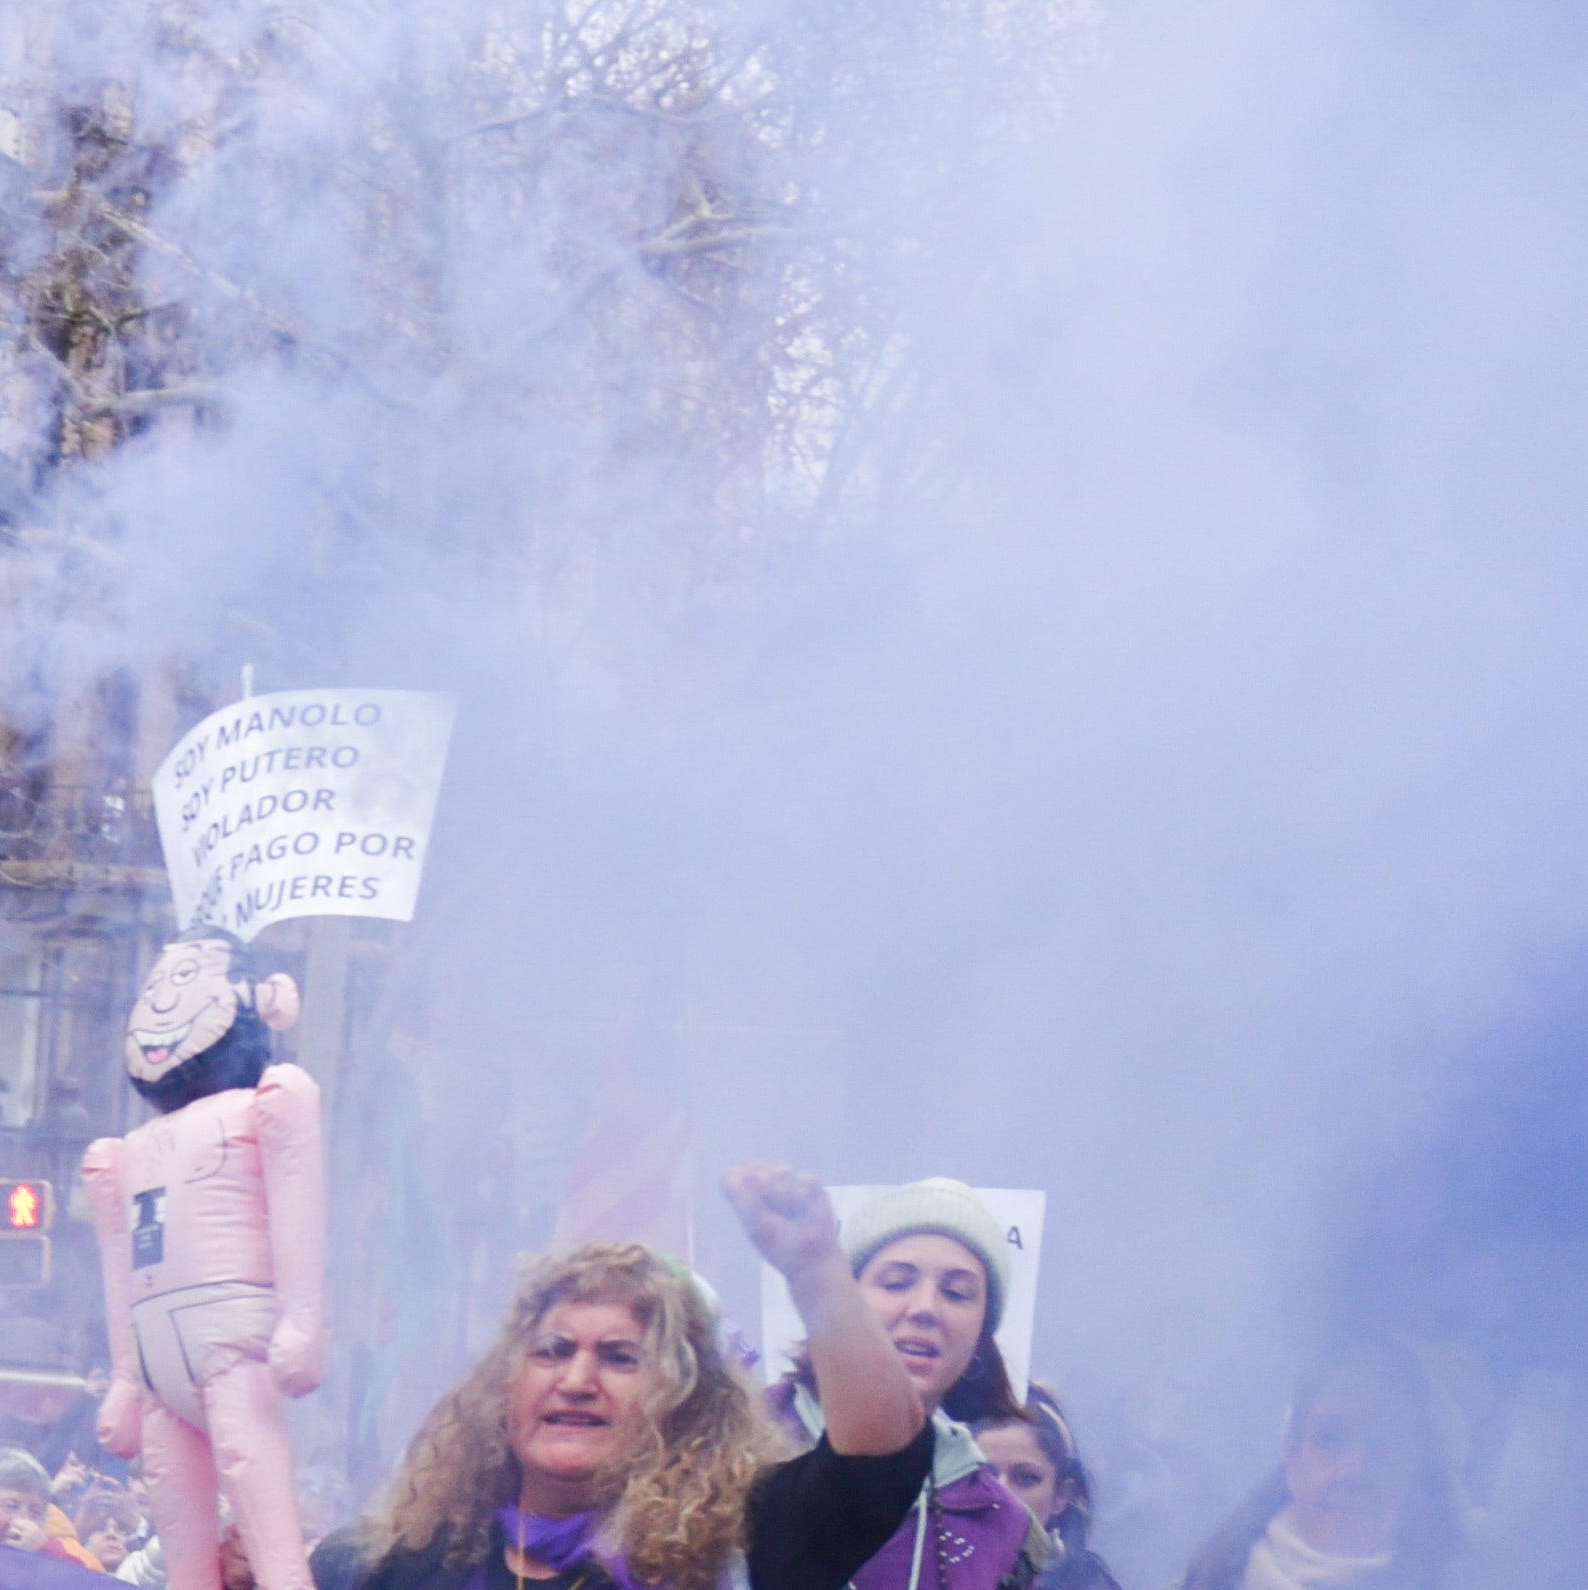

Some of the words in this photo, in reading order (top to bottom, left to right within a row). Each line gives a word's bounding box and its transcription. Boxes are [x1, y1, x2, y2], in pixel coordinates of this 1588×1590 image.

[216, 703, 382, 750] MANOLO
[220, 745, 360, 794] PUTERO
[230, 832, 319, 881] PAGO
[334, 831, 416, 860] POR
[234, 875, 381, 929] MUJERES
